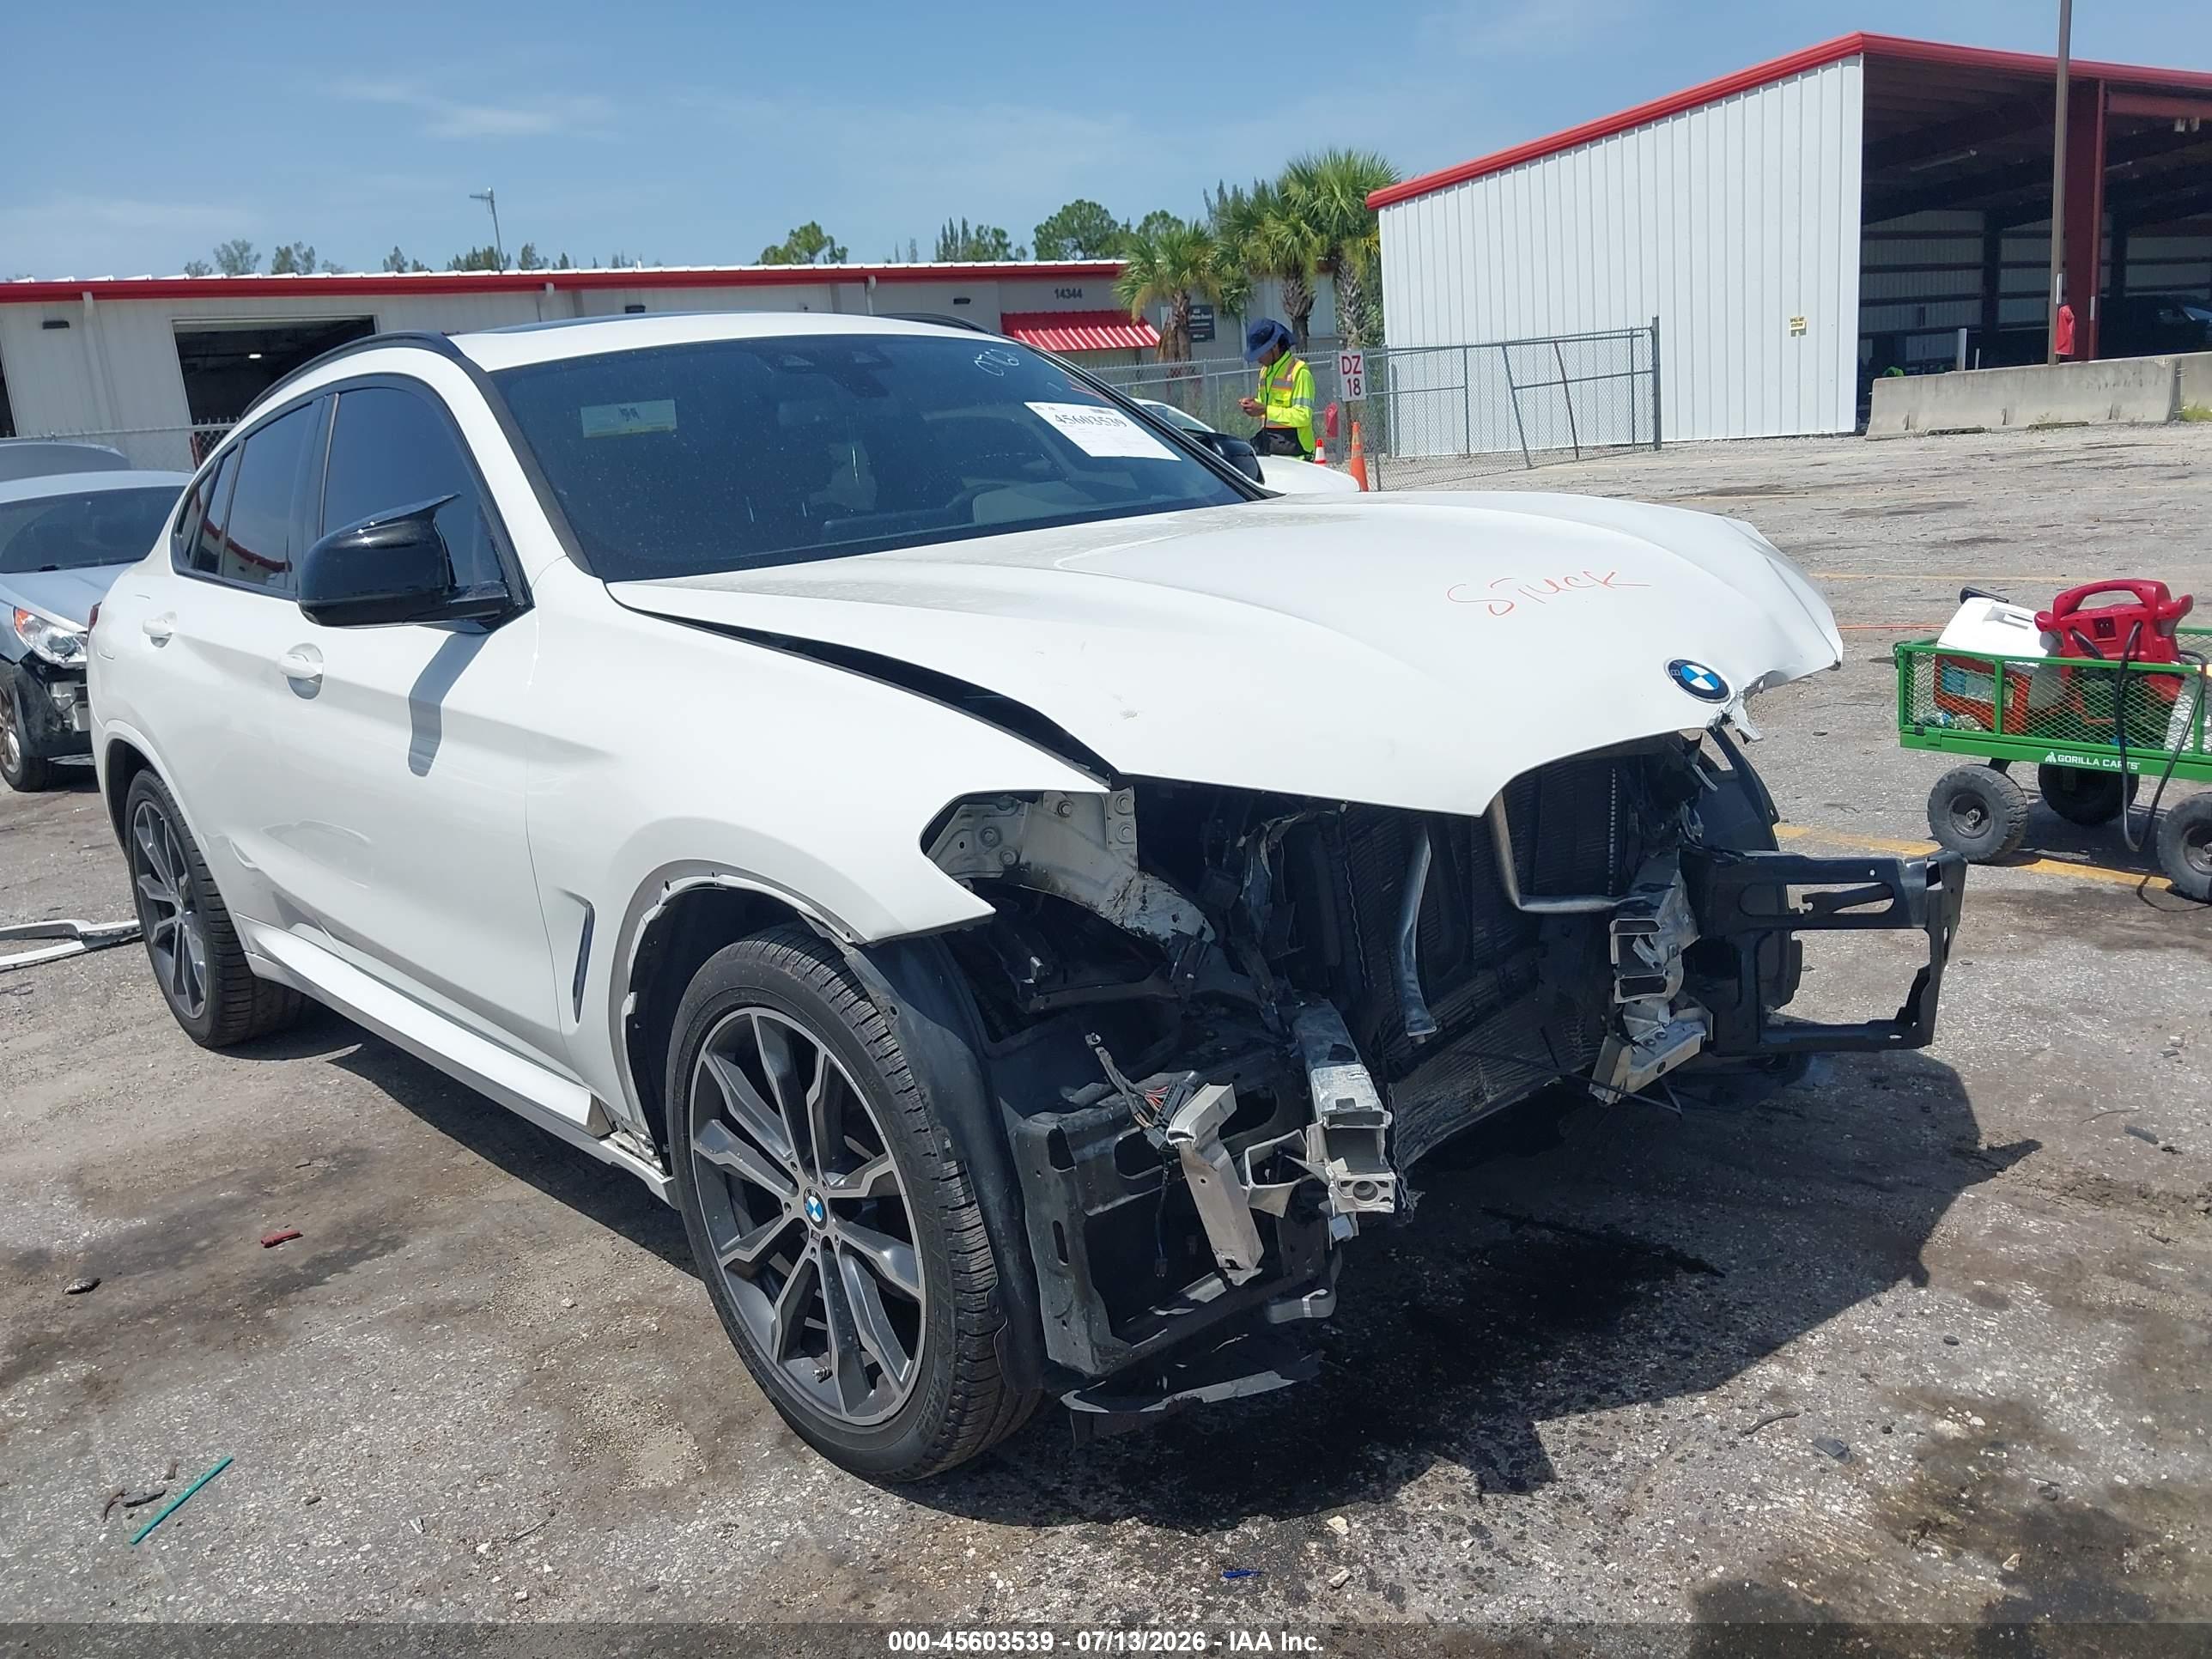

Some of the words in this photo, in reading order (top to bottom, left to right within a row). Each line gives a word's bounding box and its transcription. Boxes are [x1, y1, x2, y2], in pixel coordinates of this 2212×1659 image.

[1054, 288, 1083, 300] 14344
[1341, 355, 1362, 375] DZ
[1346, 378, 1361, 398] 18
[1054, 414, 1127, 428] 45603539
[2057, 754, 2100, 767] GORILLA
